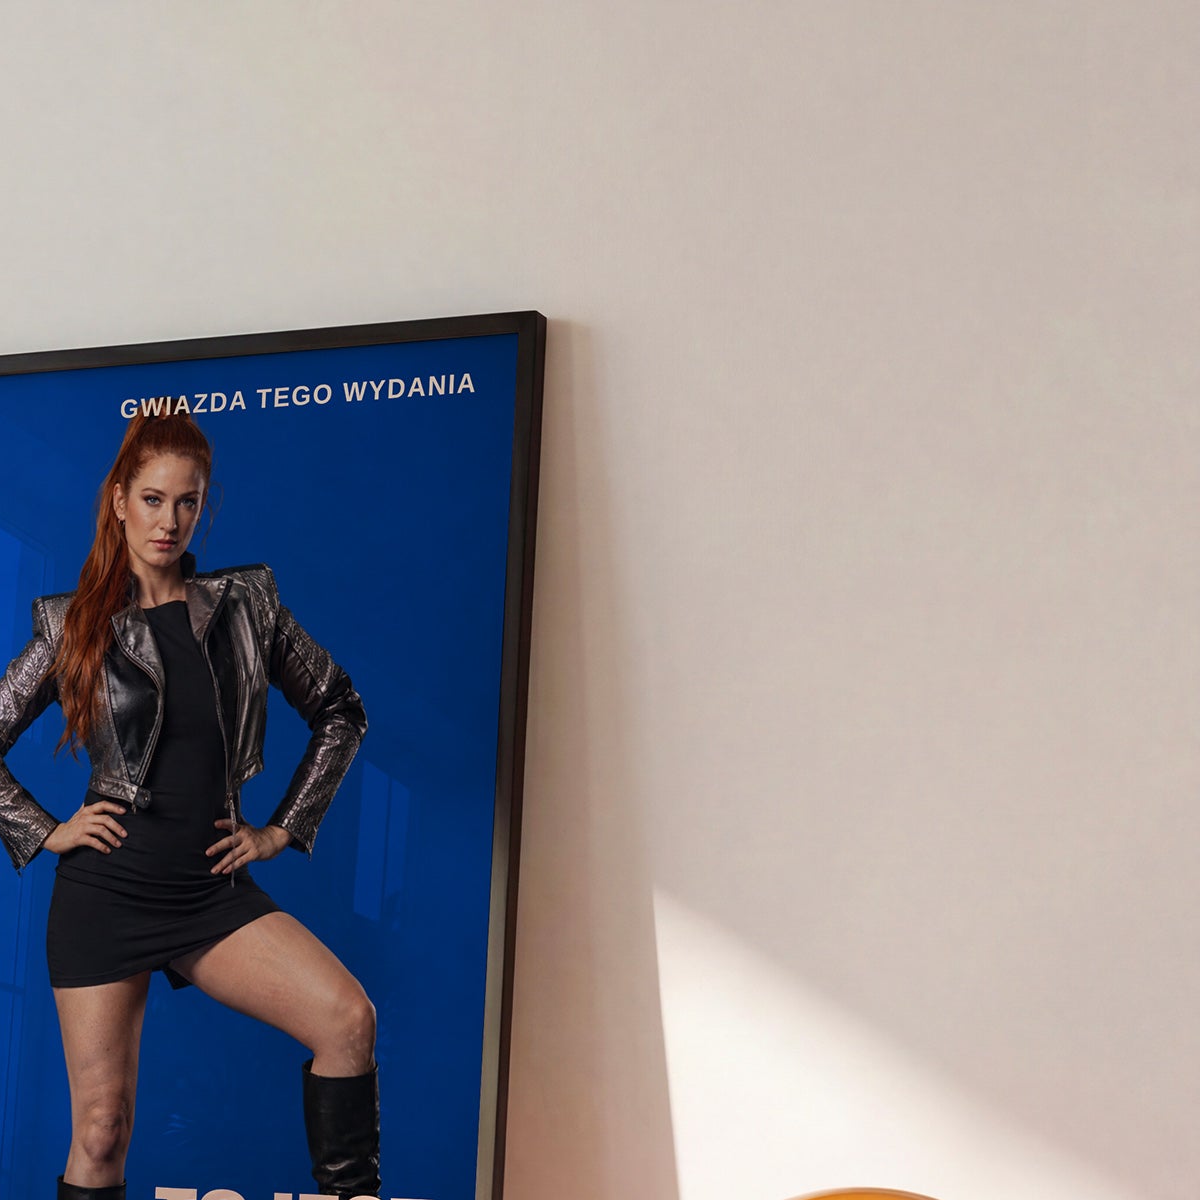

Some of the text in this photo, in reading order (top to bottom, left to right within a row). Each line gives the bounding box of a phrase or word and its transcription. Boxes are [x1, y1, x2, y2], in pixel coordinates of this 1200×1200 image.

[120, 373, 476, 419] GWIAZDA TEGO WYDANIA
